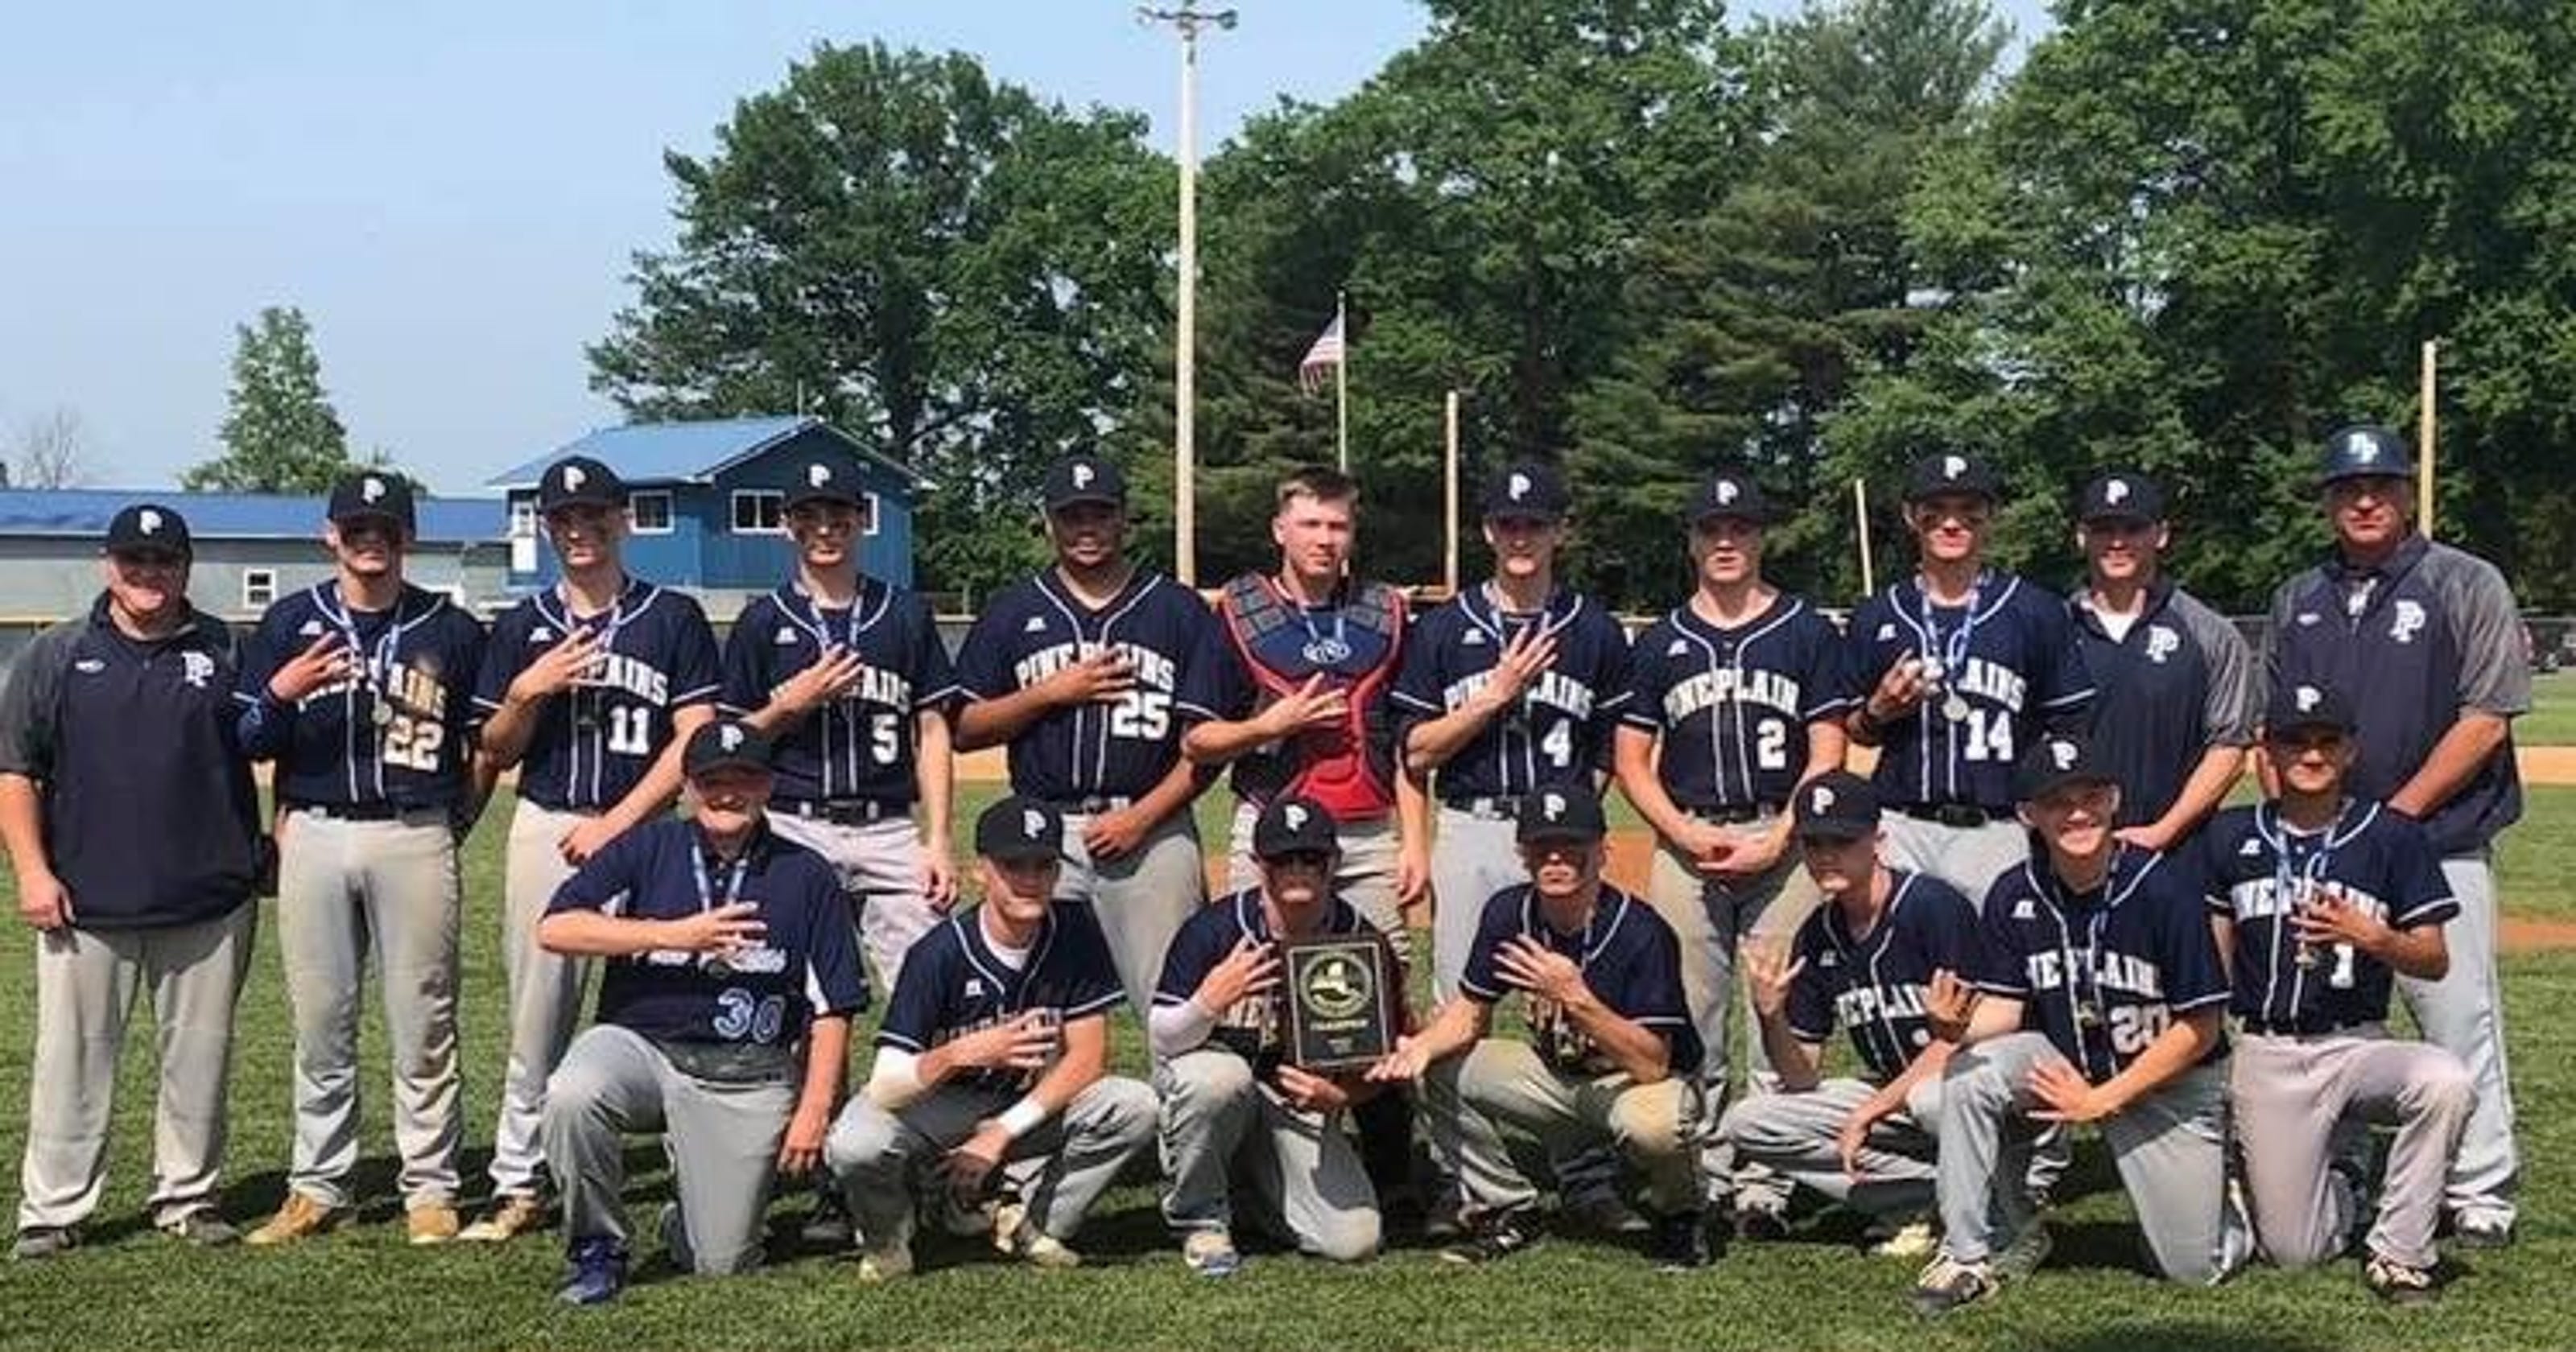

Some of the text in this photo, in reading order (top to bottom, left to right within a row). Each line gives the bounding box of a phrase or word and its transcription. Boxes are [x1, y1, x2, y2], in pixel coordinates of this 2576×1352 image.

[608, 704, 650, 755] 11
[872, 713, 899, 765] 5
[1111, 690, 1170, 740] 25
[1964, 707, 2014, 762] 14
[384, 713, 444, 773] 22
[1542, 718, 1572, 768] 4
[1757, 718, 1786, 769] 2
[712, 987, 786, 1044] 30
[2110, 1003, 2171, 1054] 20
